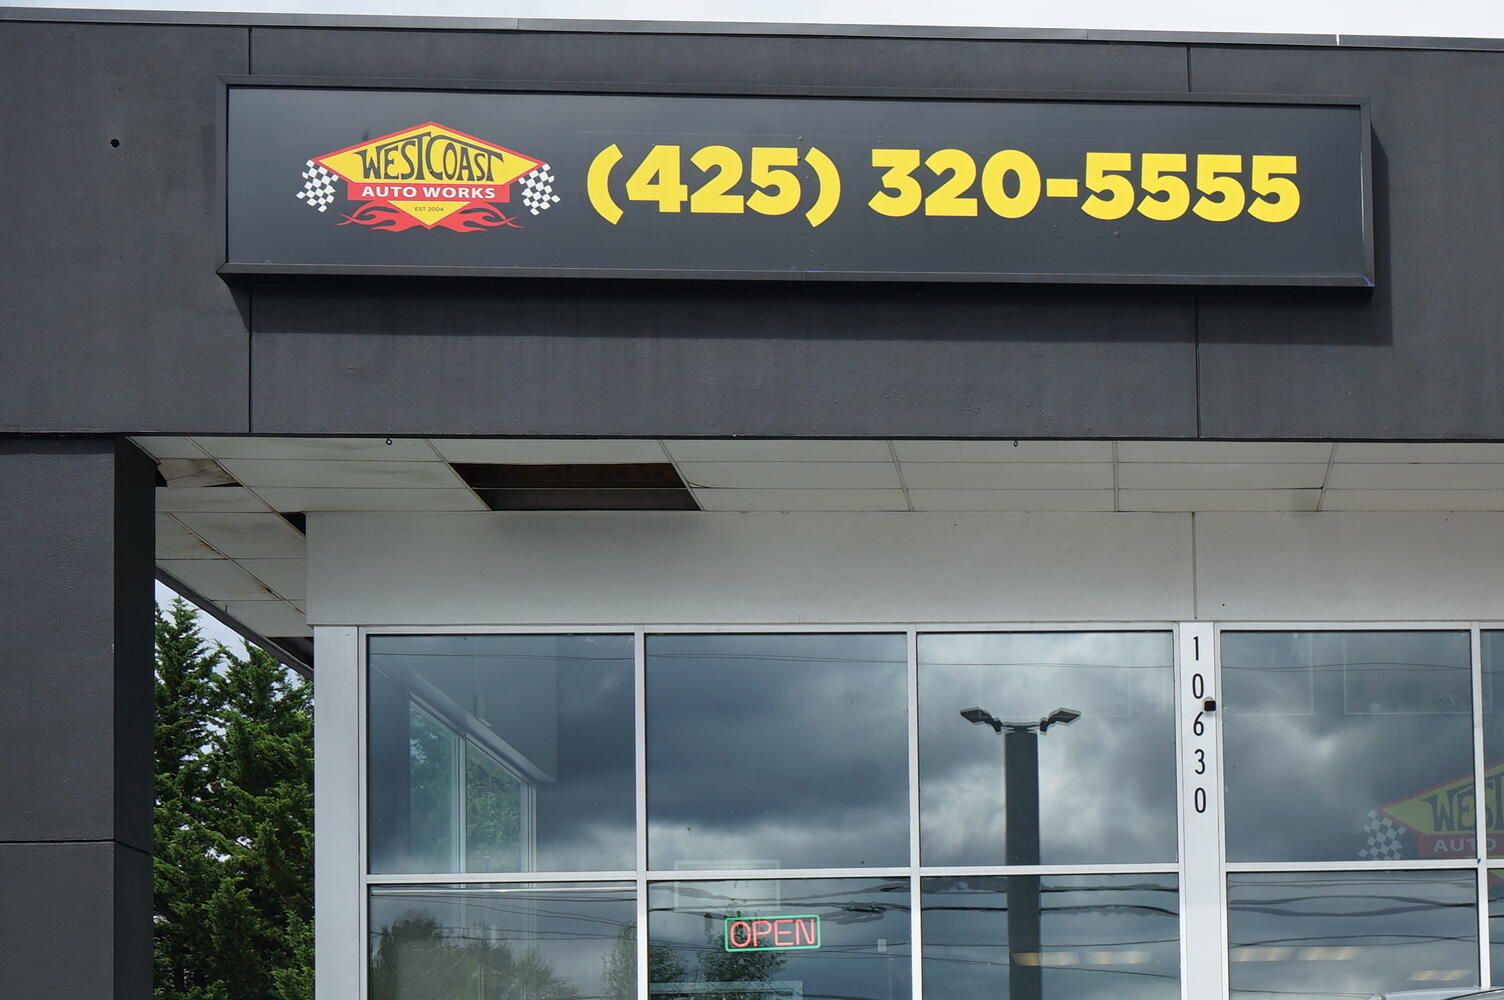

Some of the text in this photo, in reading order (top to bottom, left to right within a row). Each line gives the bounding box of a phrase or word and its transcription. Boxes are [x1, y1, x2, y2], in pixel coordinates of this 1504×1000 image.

[361, 186, 496, 199] AUTO WORKS
[587, 143, 1301, 228] (425) 320-5555
[1192, 636, 1206, 813] 10630
[730, 918, 816, 948] OPEN
